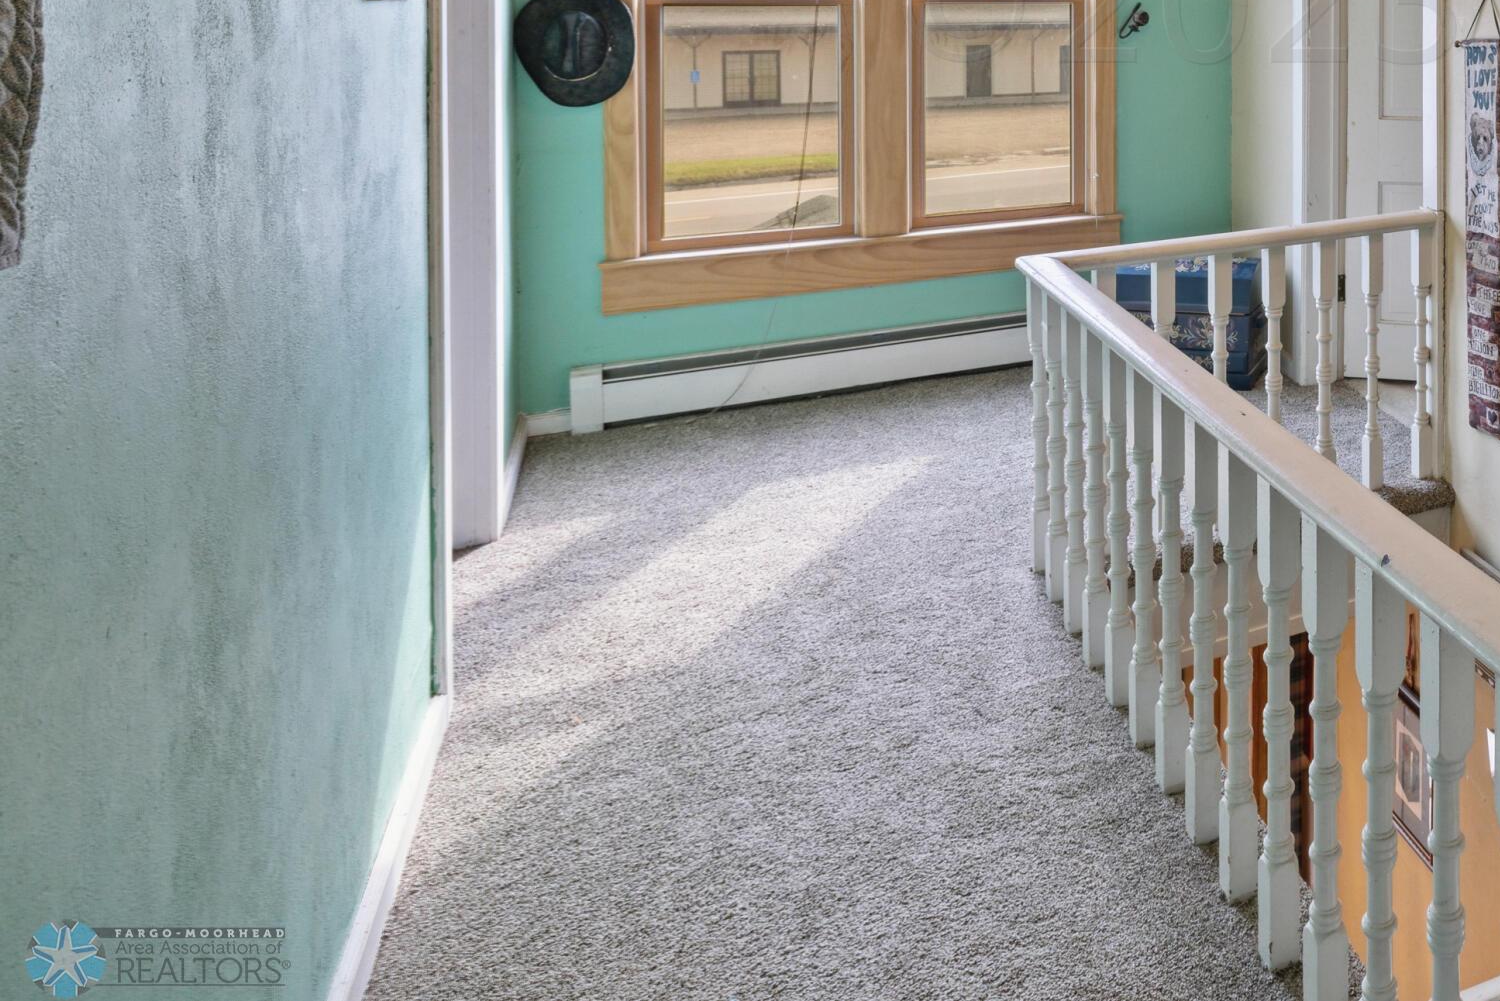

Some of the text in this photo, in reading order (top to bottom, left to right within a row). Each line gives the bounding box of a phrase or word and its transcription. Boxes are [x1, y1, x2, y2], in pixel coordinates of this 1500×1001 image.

[1465, 45, 1487, 67] HOW
[1467, 67, 1497, 89] I LOVE
[1470, 183, 1496, 202] LET ME
[1467, 214, 1482, 228] THE
